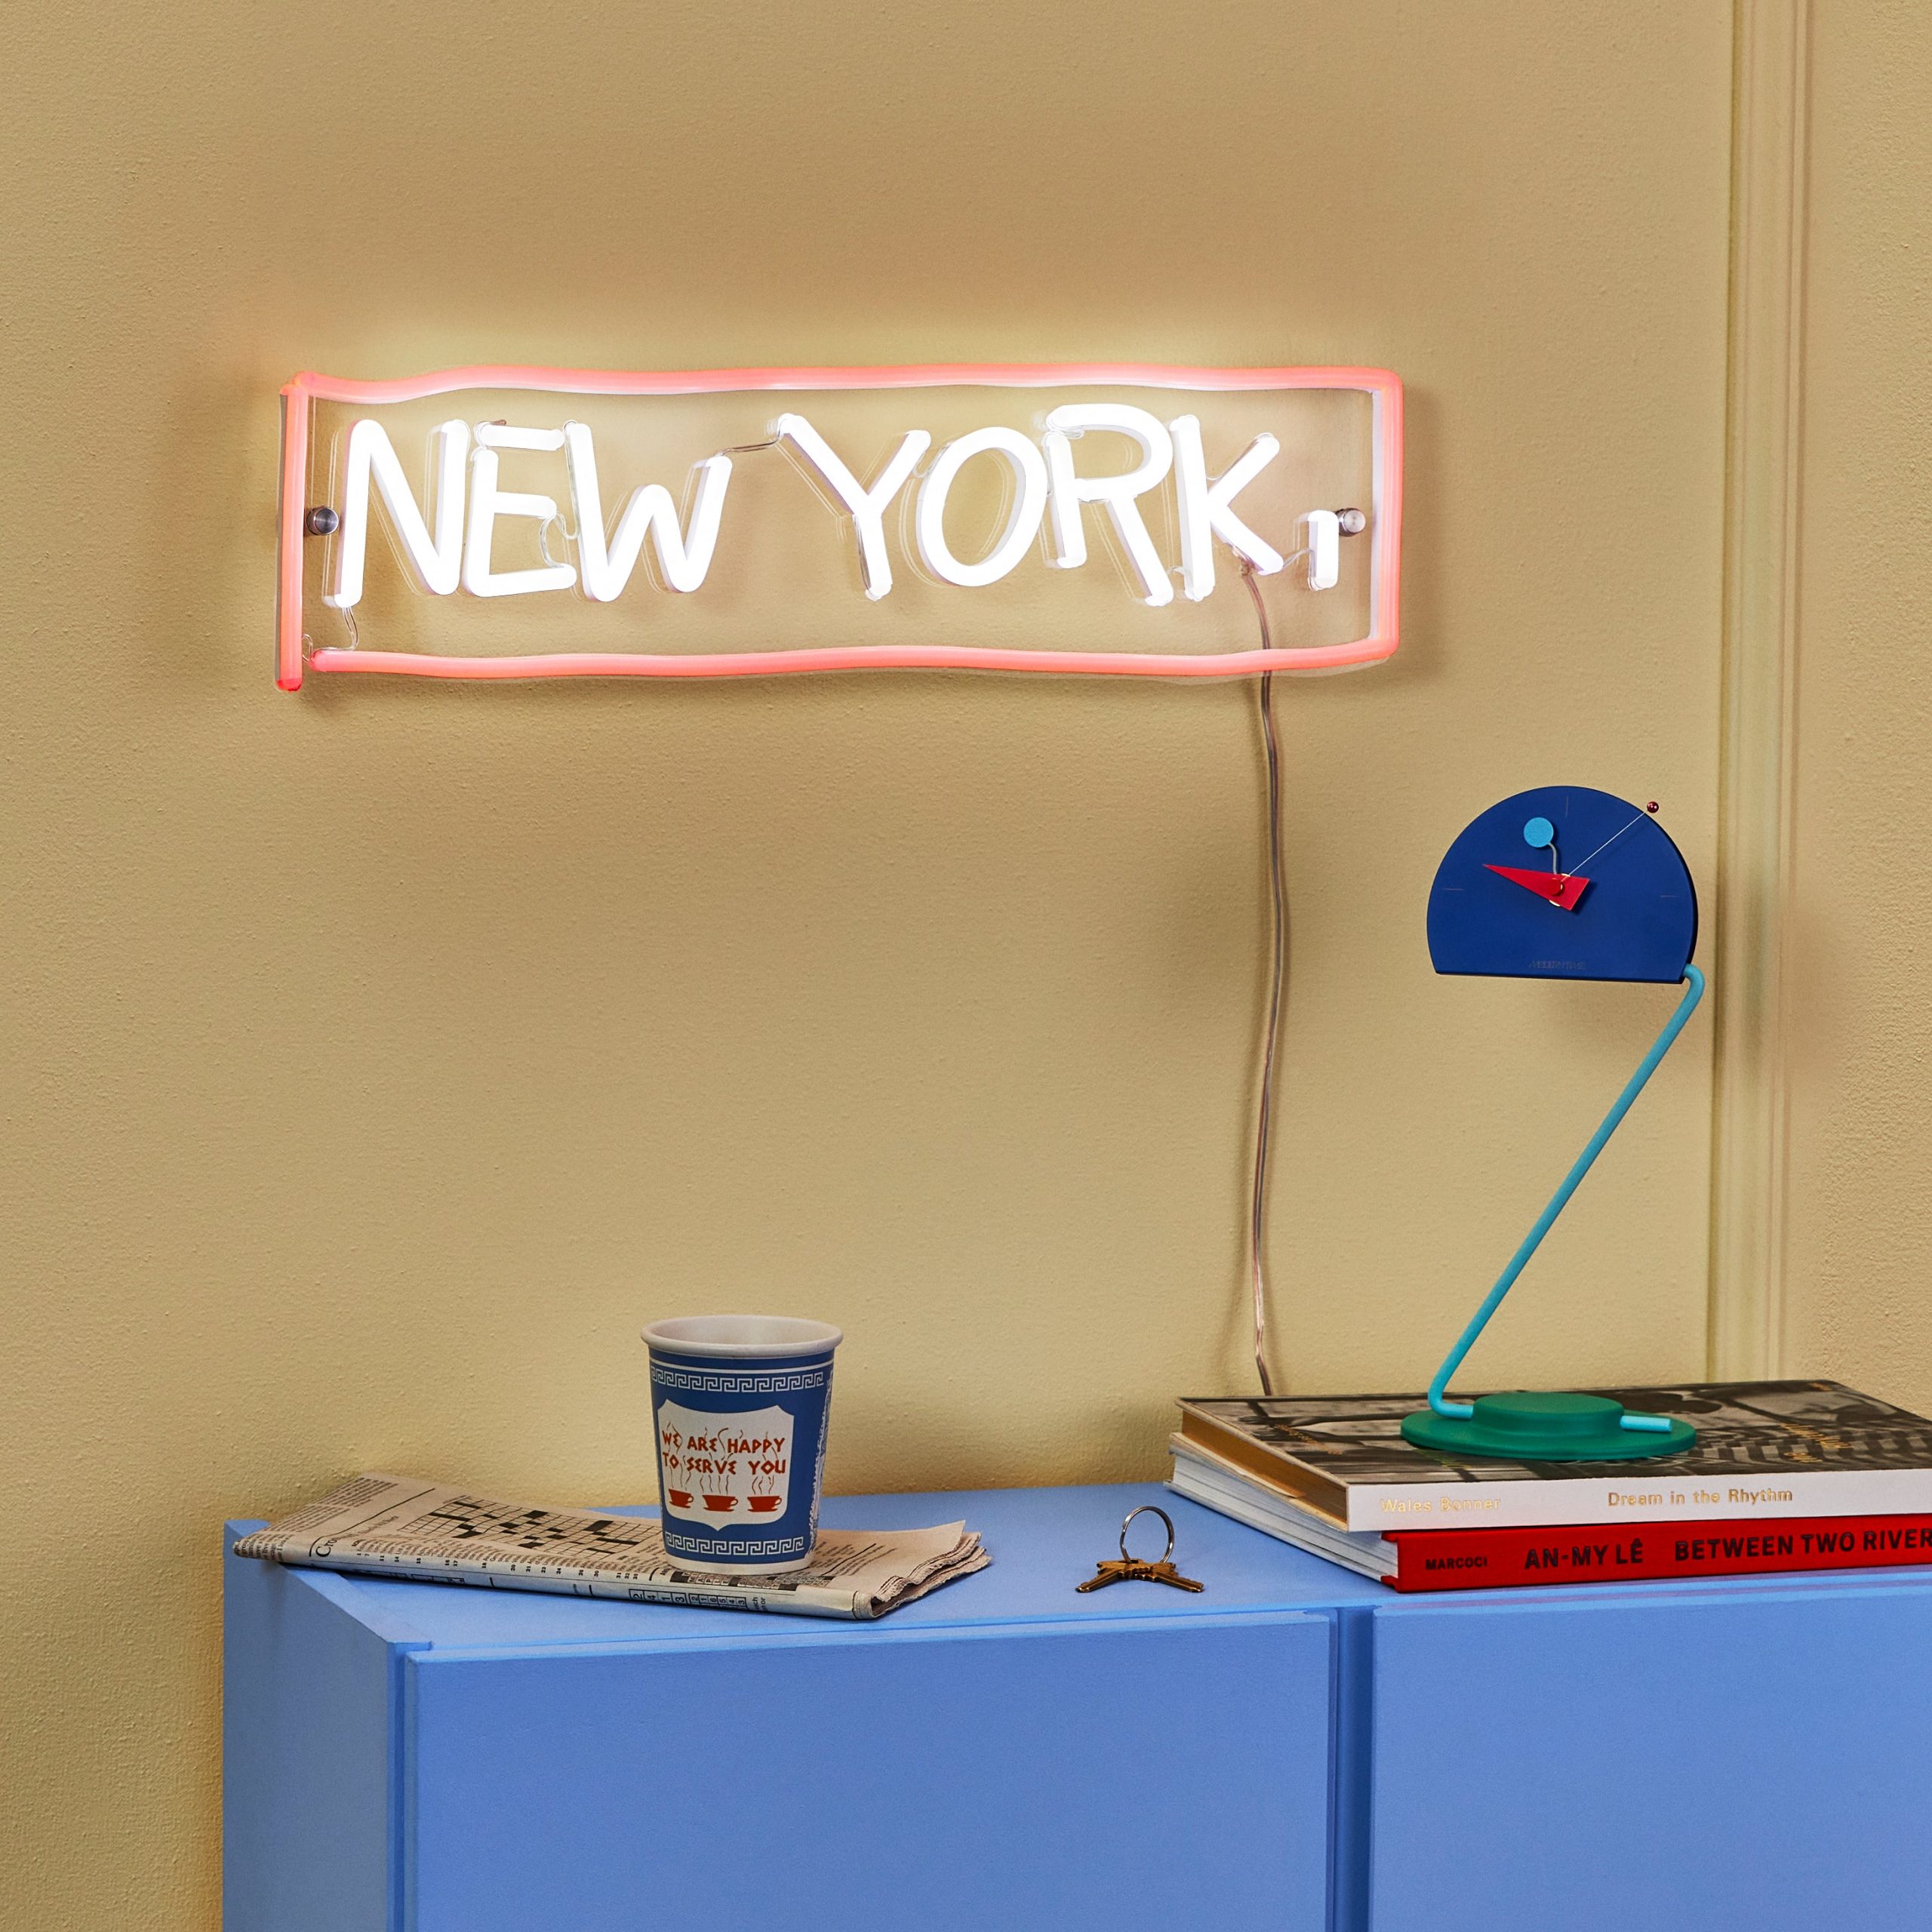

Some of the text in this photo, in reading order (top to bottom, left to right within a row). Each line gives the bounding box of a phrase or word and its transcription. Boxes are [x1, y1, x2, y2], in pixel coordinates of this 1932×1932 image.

[332, 419, 733, 608] NEW
[662, 1430, 785, 1454] WE ARE HAPPY
[663, 1452, 786, 1475] TO SERVE YOU
[1380, 1497, 1502, 1513] Wales Bonner
[1607, 1487, 1793, 1507] Dream in the Rhythm
[1426, 1556, 1488, 1571] MARCOCI
[1524, 1545, 1609, 1570] AN-MY
[1616, 1537, 1644, 1564] LÊ
[1675, 1535, 1793, 1561] BETWEEN
[1801, 1532, 1855, 1554] TWO
